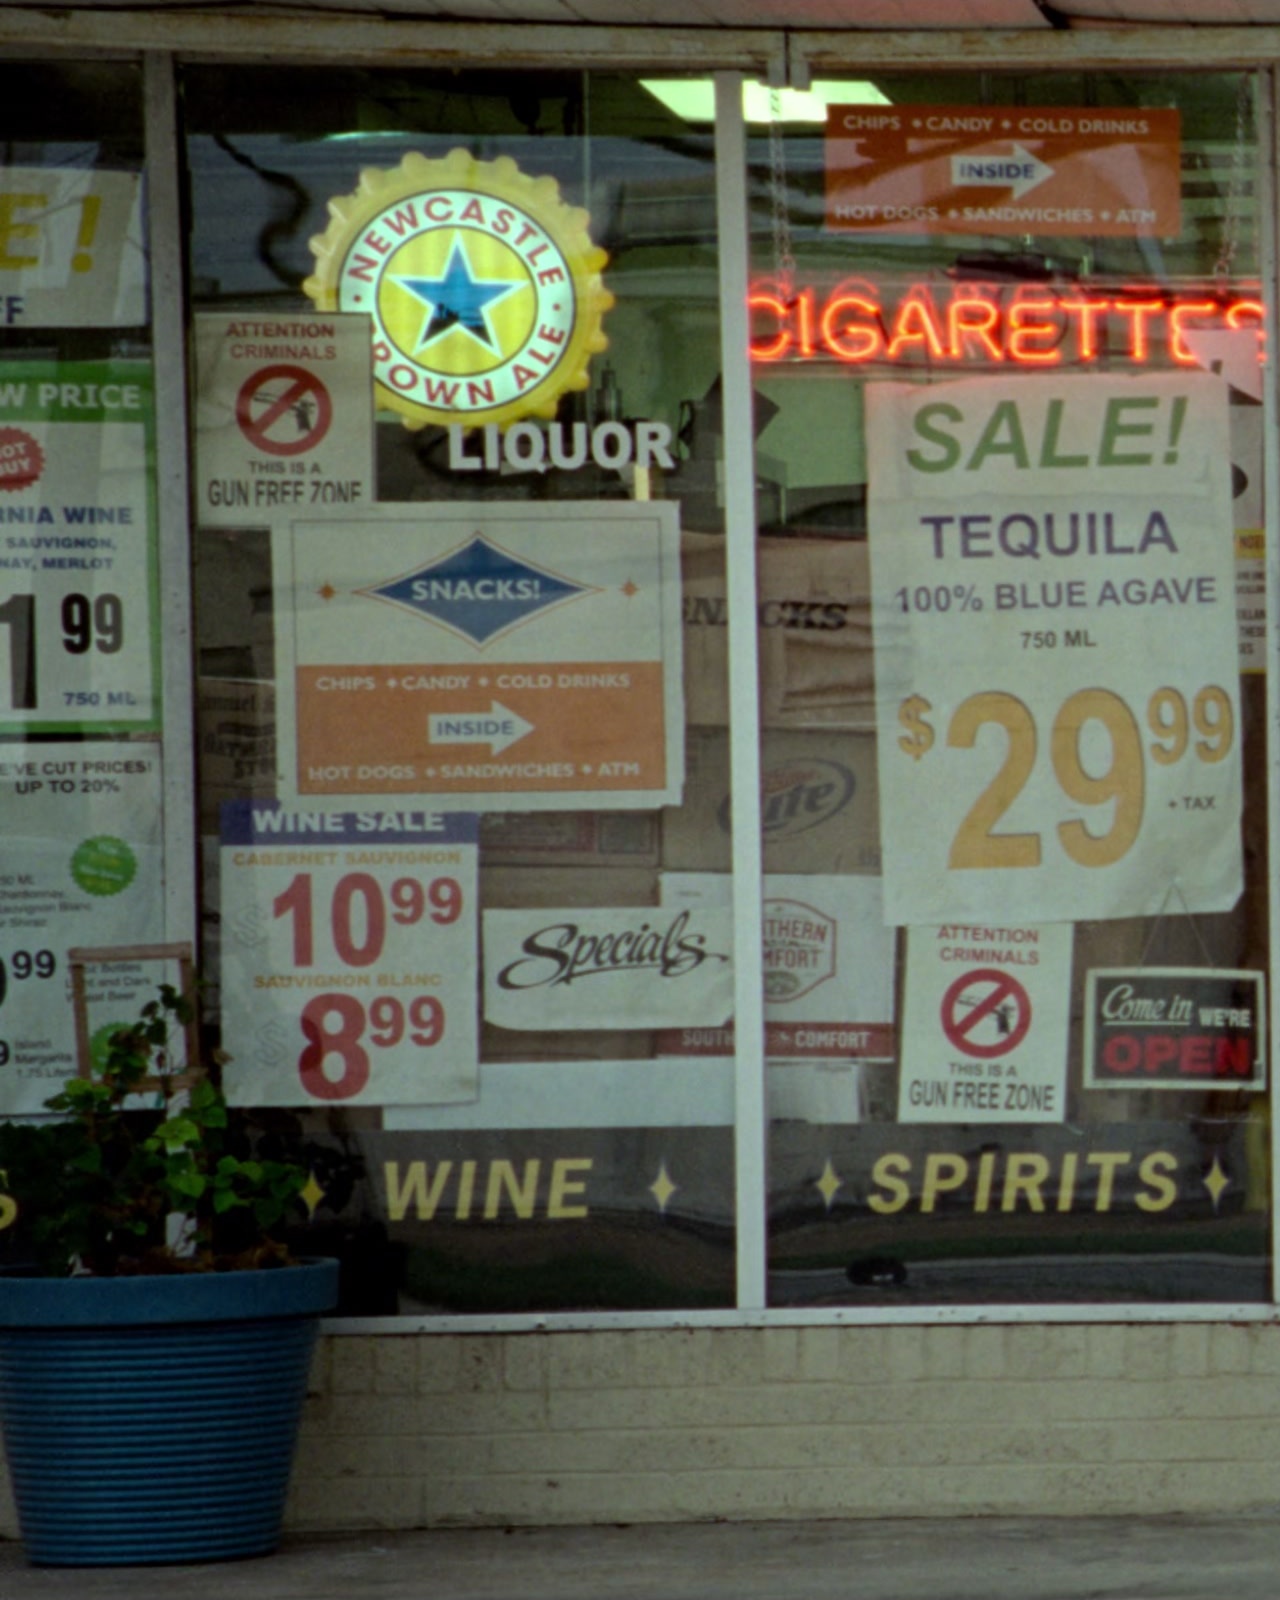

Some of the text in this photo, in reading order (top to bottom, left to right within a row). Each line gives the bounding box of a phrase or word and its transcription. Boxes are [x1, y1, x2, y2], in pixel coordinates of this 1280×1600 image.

[844, 115, 1149, 135] CHIPS CANDY COLD DRINKS
[959, 162, 1035, 180] INSIDE
[836, 205, 1156, 224] HOT DOGS SANDWICHES ATM
[347, 194, 565, 288] NEWCASTLE
[226, 321, 335, 339] ATTENTION
[230, 343, 337, 361] CRIMINALS
[371, 318, 565, 406] ROWN ALE
[39, 383, 142, 409] PRICE
[906, 395, 1188, 474] SALE!
[448, 421, 675, 475] LIQUOR
[208, 479, 249, 507] GUN
[63, 506, 134, 524] WINE
[920, 510, 1179, 559] TEQUILA
[42, 557, 114, 571] MERLOT
[412, 579, 541, 600] SNACKS!
[897, 577, 1217, 615] 100% BLUE AGAVE
[1019, 629, 1097, 649] 750 ML
[315, 673, 631, 691] CHIPS CANDY COLD DRINKS
[436, 719, 515, 738] INSIDE
[308, 761, 640, 782] HOT DOGS SANDWICHES ATM
[252, 810, 445, 834] WINE SALE
[232, 850, 462, 867] CABERNET SAUVIGNON
[938, 924, 1040, 944] ATTENTION
[497, 911, 730, 990] Specials
[939, 946, 1040, 966] CRIMINALS
[253, 972, 442, 989] SAUVIGNON BLANC
[1101, 984, 1250, 1029] Come in WE'RE
[1103, 1035, 1250, 1076] OPEN
[909, 1079, 1055, 1112] GUN FREE ZONE
[383, 1157, 595, 1222] WINE
[866, 1151, 1179, 1213] SPIRITS
